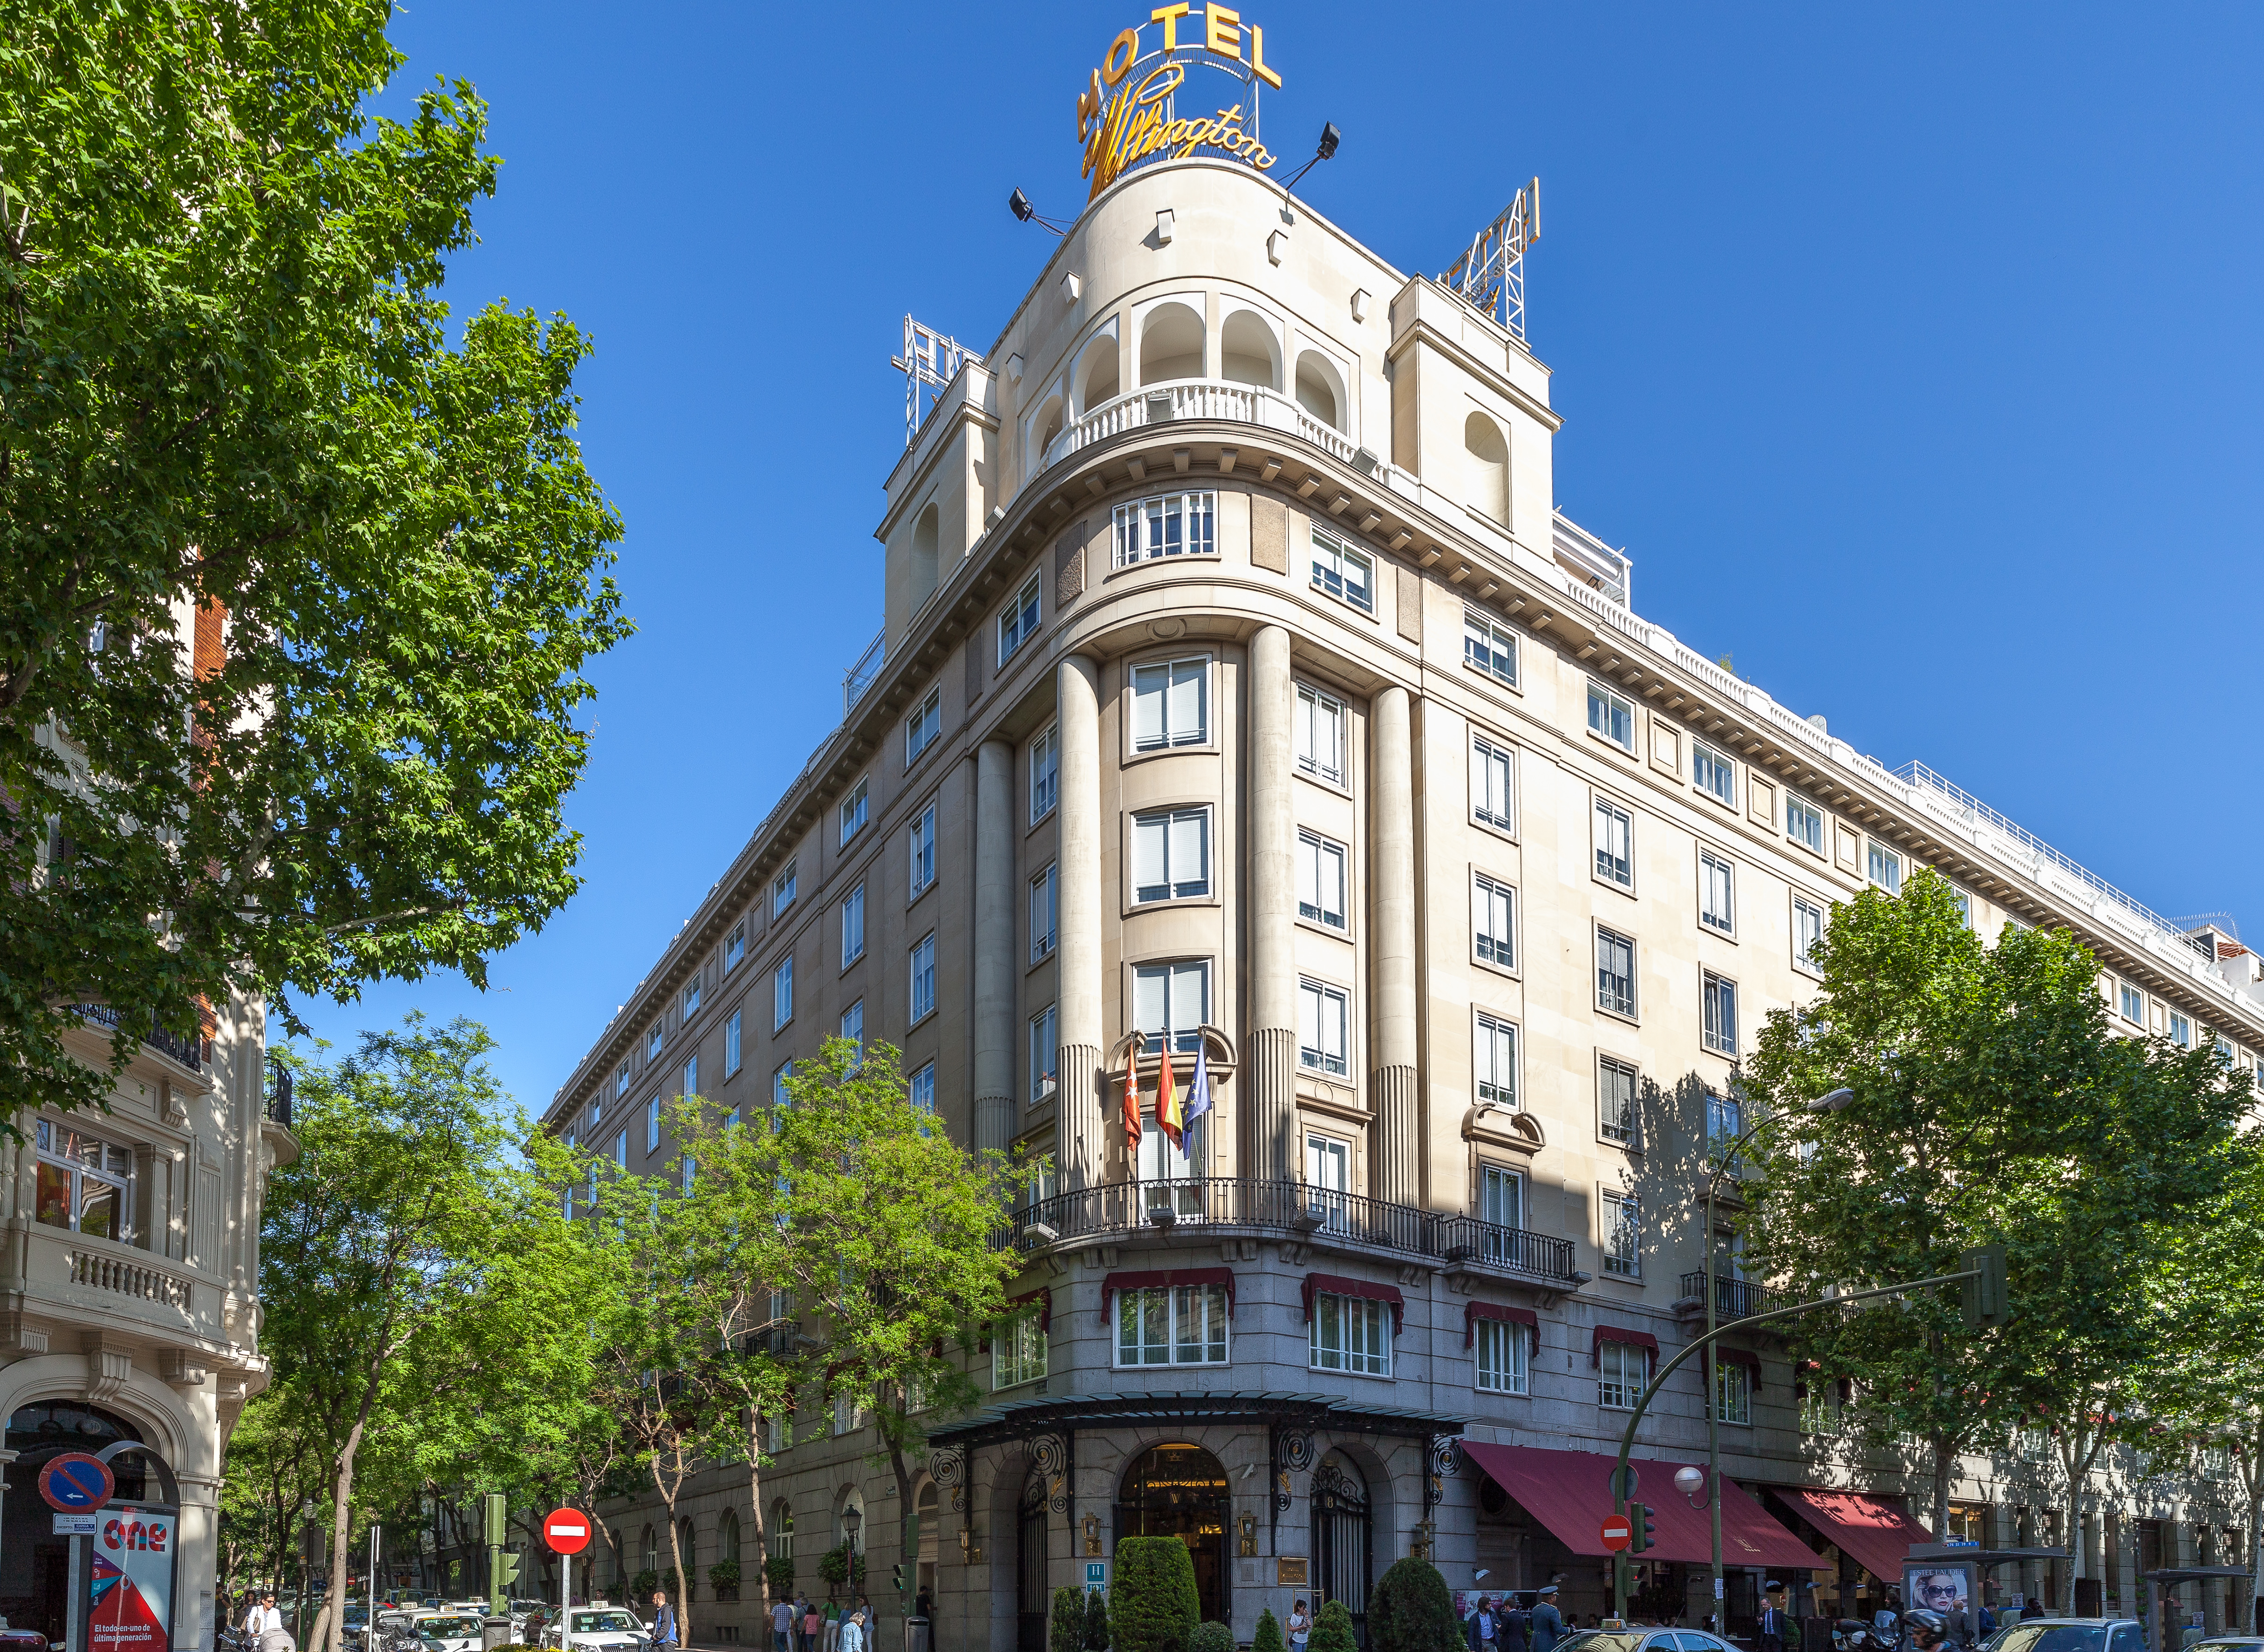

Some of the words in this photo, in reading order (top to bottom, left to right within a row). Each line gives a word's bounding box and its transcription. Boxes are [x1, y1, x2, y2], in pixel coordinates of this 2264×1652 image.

[1077, 1, 1282, 144] HOTEL
[1082, 63, 1277, 207] Wellington
[1328, 1496, 1333, 1508] 8
[103, 1518, 167, 1552] one
[1091, 1565, 1100, 1575] H
[94, 1633, 116, 1642] última
[116, 1632, 152, 1643] generación
